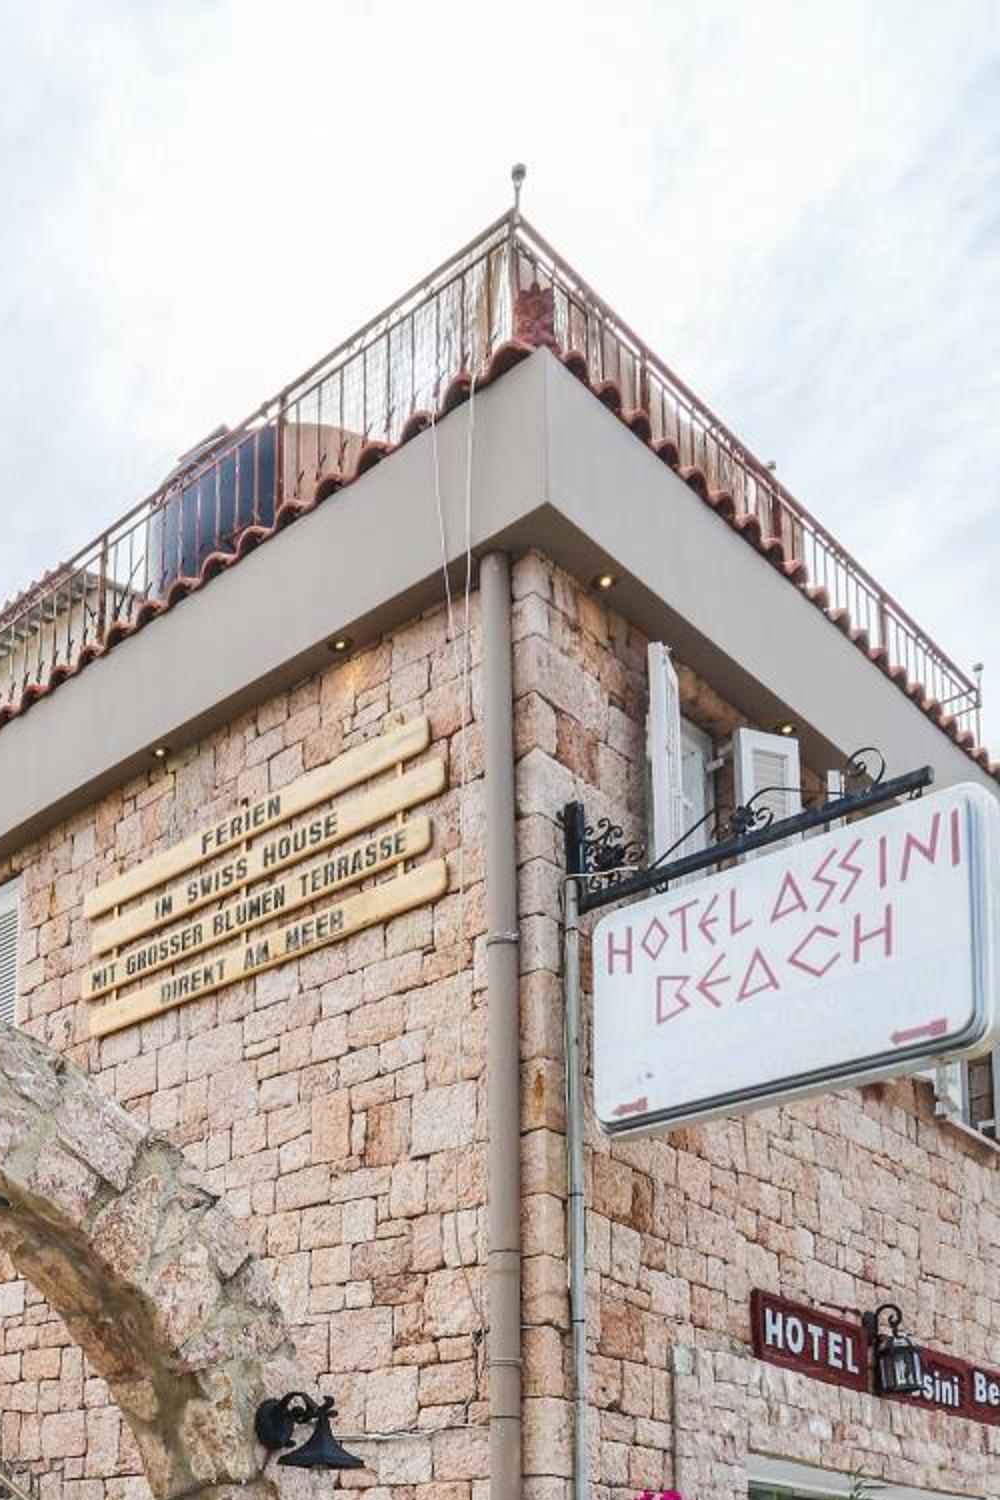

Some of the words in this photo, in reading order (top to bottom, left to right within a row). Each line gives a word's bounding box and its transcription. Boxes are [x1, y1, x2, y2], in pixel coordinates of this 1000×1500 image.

[187, 857, 248, 904] SWISS
[262, 812, 338, 868] HOUSE
[201, 795, 281, 855] FERIEN
[91, 962, 117, 992] MIT
[126, 922, 204, 975] GROSSER
[213, 884, 285, 936] BLUMEN
[299, 828, 408, 897] TERRASSE
[606, 887, 752, 977] HOTEL
[770, 807, 962, 923] ASSINI
[160, 958, 227, 1004] DIREKT
[243, 939, 271, 971] AM
[655, 902, 893, 1026] BEACH
[764, 1307, 859, 1375] HOTEL
